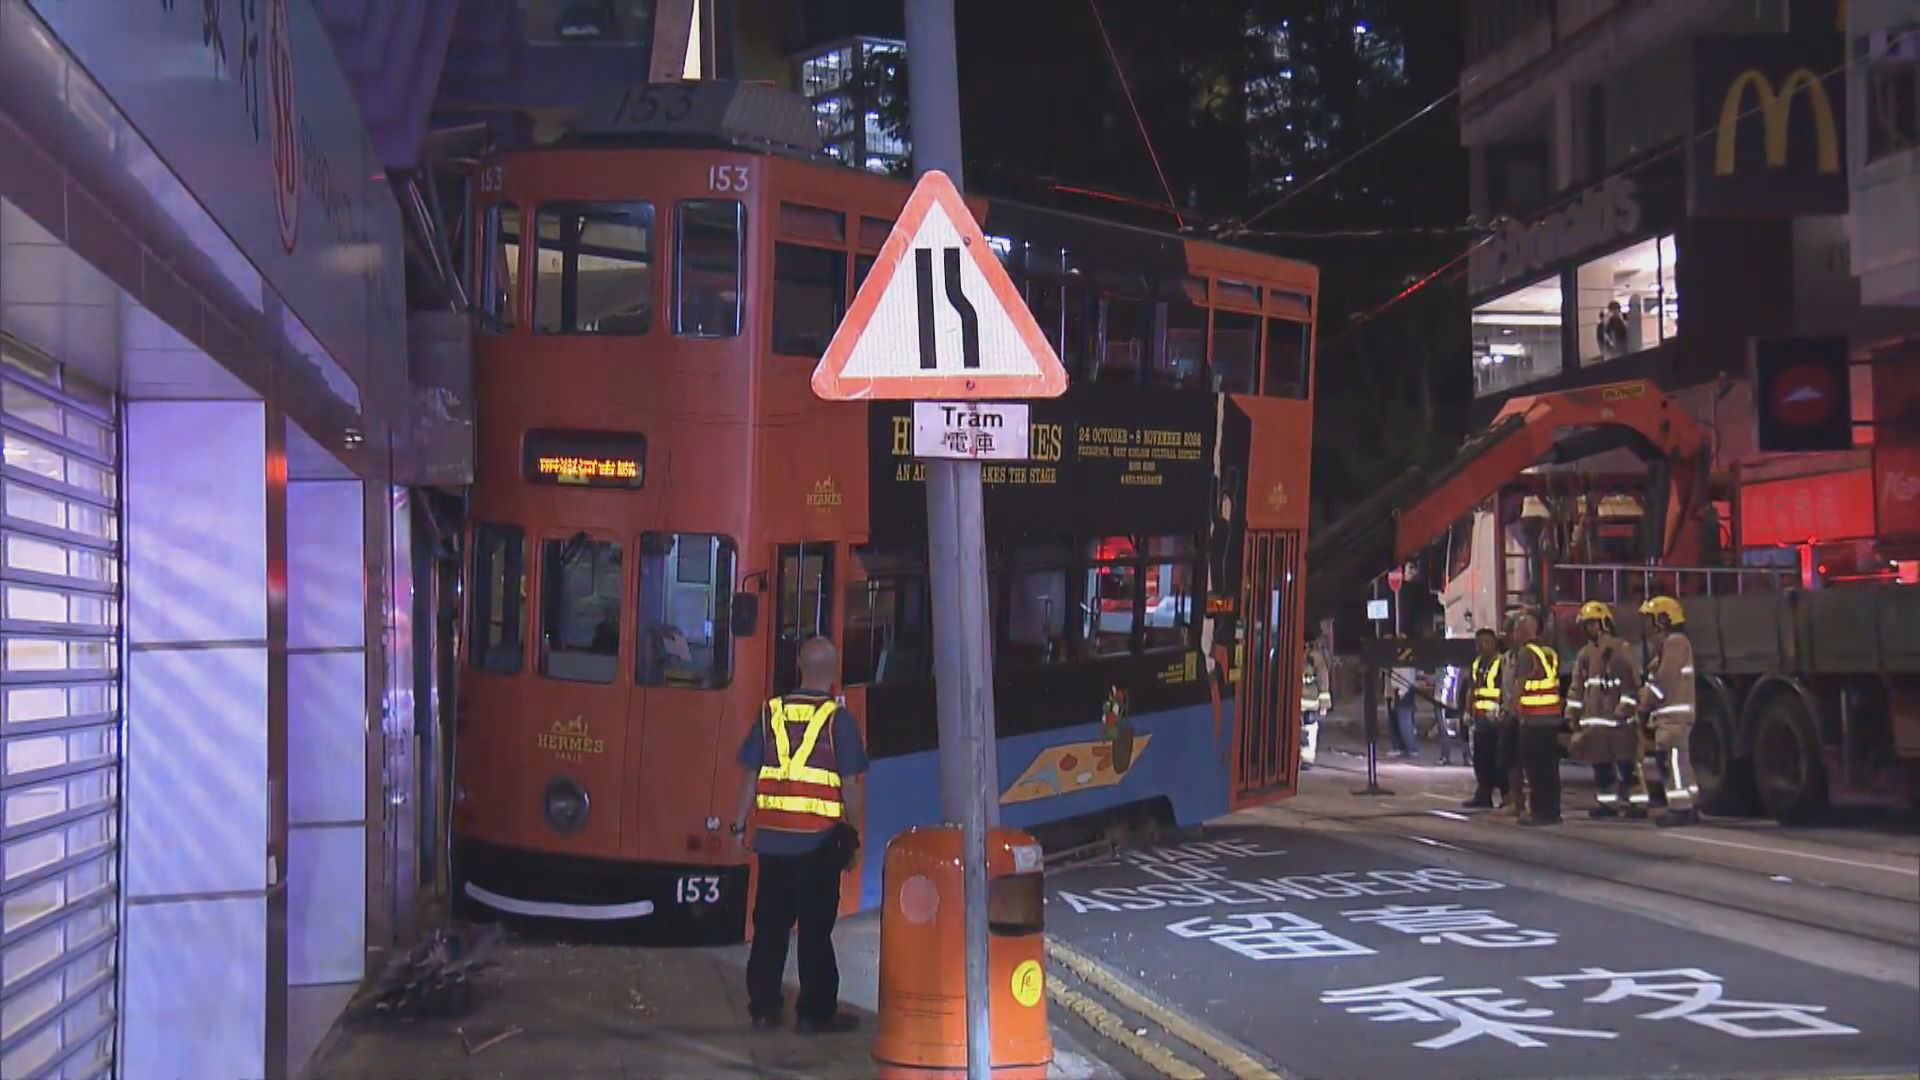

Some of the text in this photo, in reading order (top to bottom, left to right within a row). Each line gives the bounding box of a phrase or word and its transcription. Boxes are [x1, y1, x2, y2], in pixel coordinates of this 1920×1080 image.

[613, 84, 695, 122] 153
[480, 167, 502, 192] 153
[708, 165, 749, 191] 153
[940, 405, 1003, 428] Tram
[1079, 426, 1090, 442] 24
[1092, 428, 1128, 444] OCTOBER
[1143, 430, 1182, 446] NOVEMBER
[896, 464, 910, 481] AN
[982, 466, 1006, 483] AKES
[1008, 467, 1027, 484] THE
[1029, 467, 1057, 484] STAGE
[676, 876, 720, 904] 153
[1055, 866, 1507, 914] ASSENGERS
